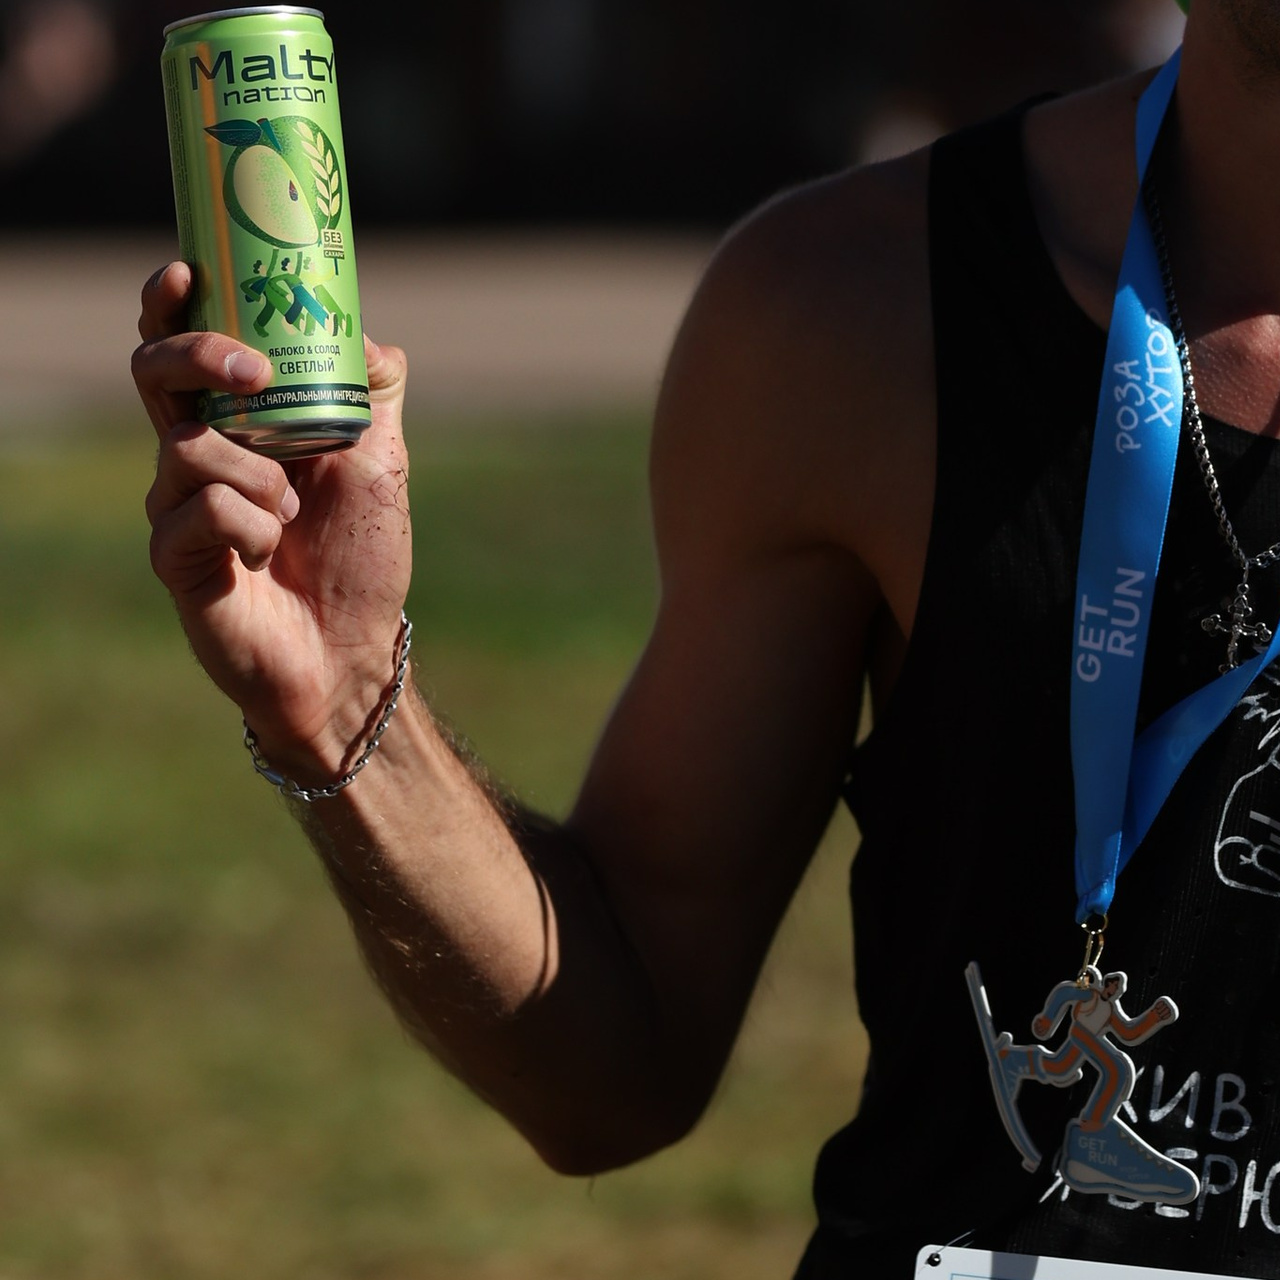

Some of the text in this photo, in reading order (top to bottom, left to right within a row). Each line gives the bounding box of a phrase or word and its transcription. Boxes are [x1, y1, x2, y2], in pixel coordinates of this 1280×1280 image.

[223, 86, 326, 106] nation
[323, 231, 342, 244] БЕЗ
[268, 344, 341, 358] ЯБЛОКО & СОЛОД
[279, 357, 335, 376] СВЕТЛЫЙ
[260, 394, 266, 406] С
[266, 390, 333, 405] НАТУРАЛЬНЫМИ
[1113, 358, 1142, 454] РОЗА
[1107, 567, 1146, 658] RUN
[1075, 593, 1109, 683] GET
[1077, 1135, 1107, 1152] GET
[1088, 1150, 1119, 1167] RUN
